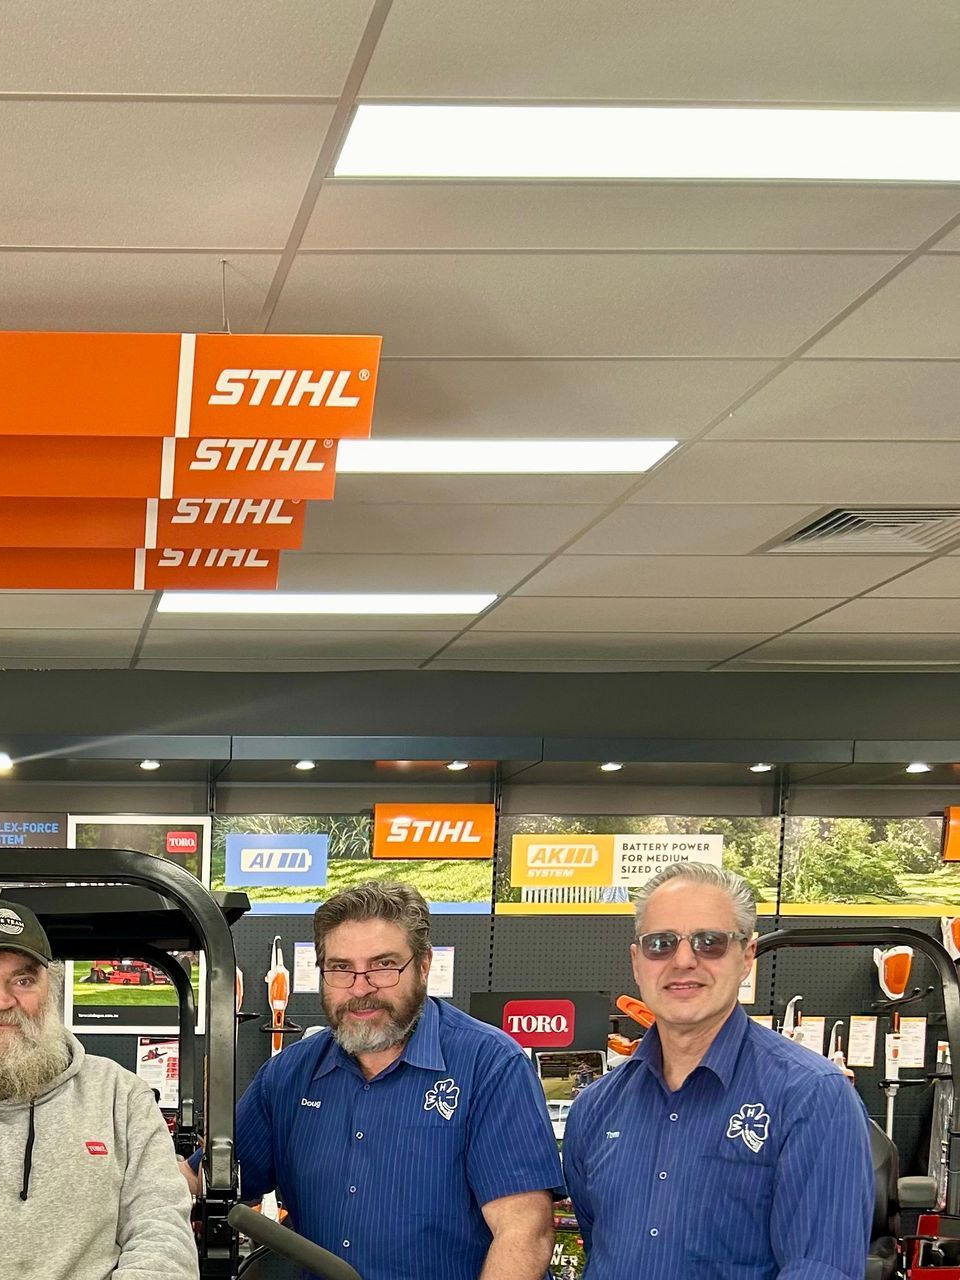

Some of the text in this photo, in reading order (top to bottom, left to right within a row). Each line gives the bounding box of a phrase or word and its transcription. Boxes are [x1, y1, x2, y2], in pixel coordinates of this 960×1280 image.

[386, 817, 481, 842] STIHL
[169, 837, 195, 847] TORO
[622, 843, 710, 851] BATTERY POWER
[621, 854, 689, 862] FOR MEDIUM
[527, 869, 575, 877] SYSTEM
[621, 865, 652, 873] SIZED
[507, 1015, 569, 1033] TORO
[301, 1098, 322, 1109] Doug
